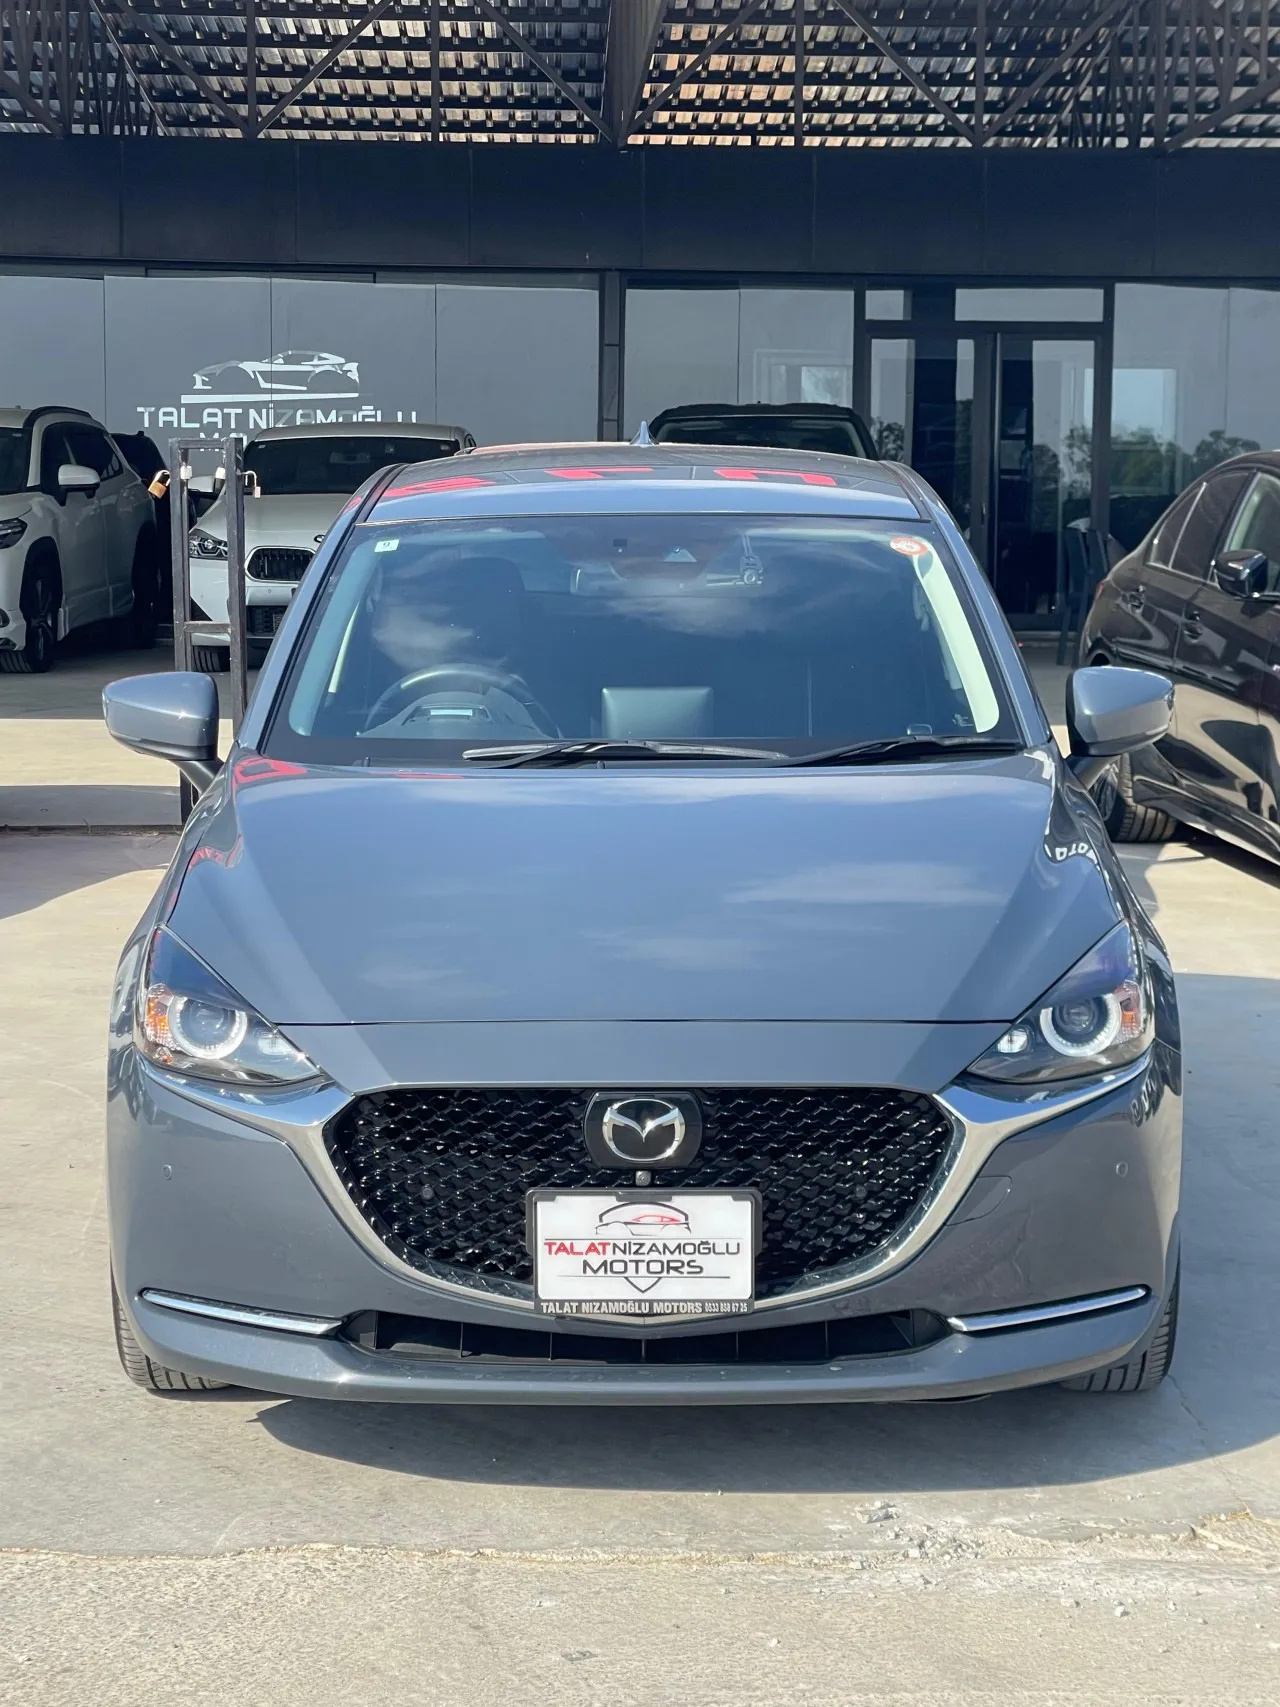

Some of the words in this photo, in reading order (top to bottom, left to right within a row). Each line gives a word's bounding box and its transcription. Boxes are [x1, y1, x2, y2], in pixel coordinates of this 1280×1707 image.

[137, 406, 242, 428] TALAT
[582, 1259, 704, 1275] MOTORS
[541, 1302, 578, 1313] TALAT
[653, 1302, 702, 1313] MOTORS
